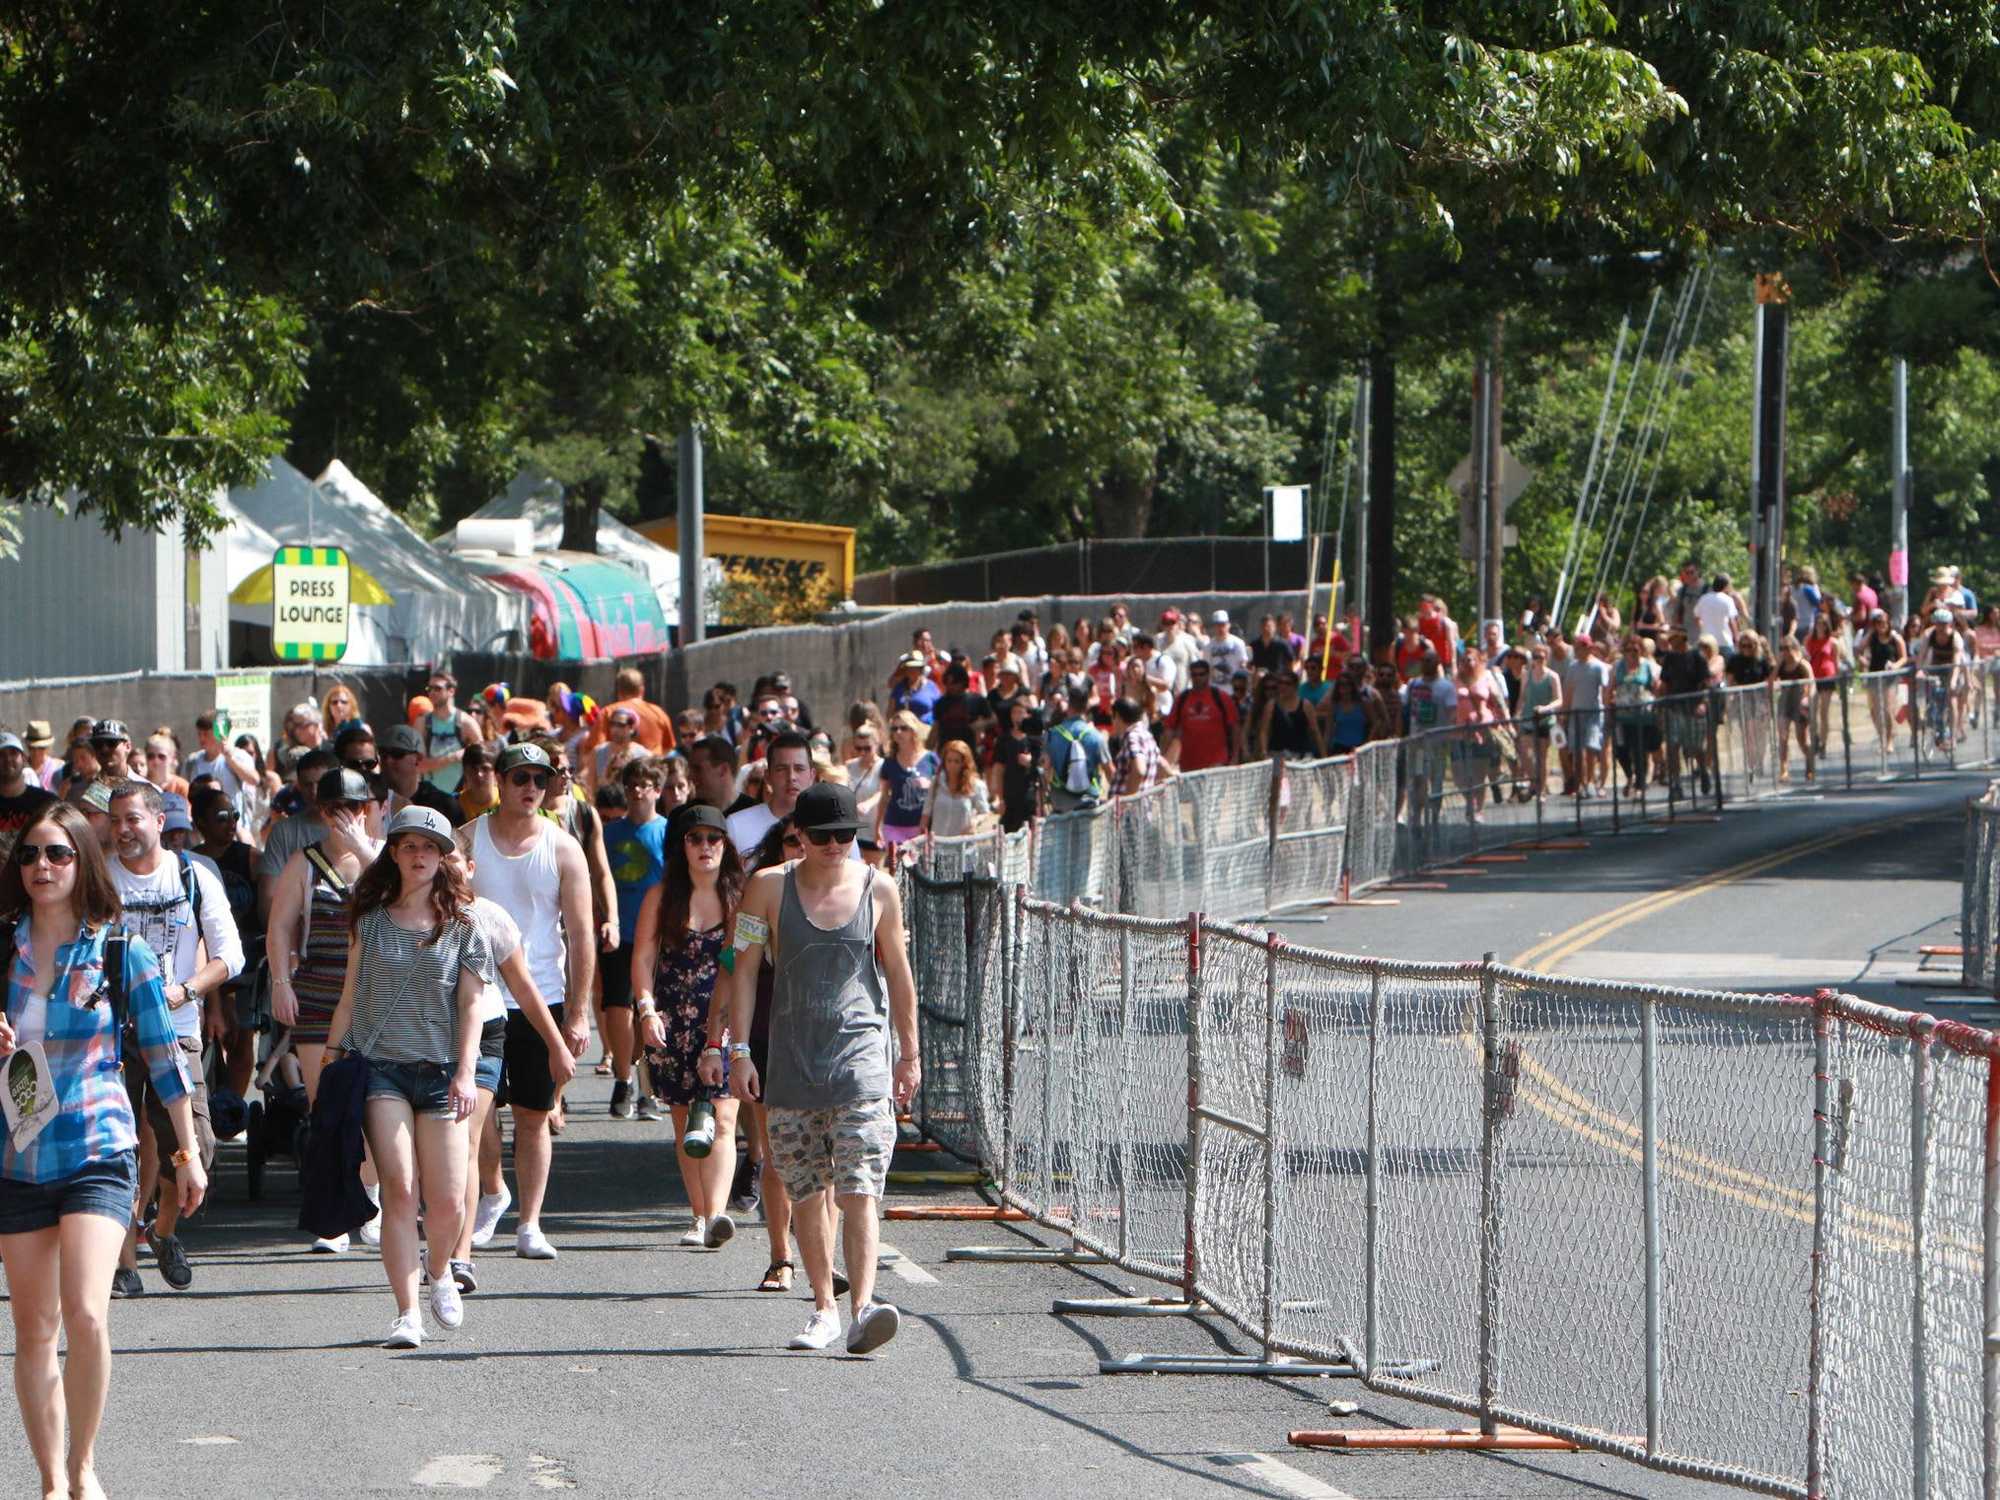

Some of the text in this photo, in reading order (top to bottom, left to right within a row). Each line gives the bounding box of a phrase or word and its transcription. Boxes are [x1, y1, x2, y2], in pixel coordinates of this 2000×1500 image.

[290, 581, 335, 597] PRESS
[280, 606, 343, 623] LOUNGE
[424, 812, 436, 828] LA
